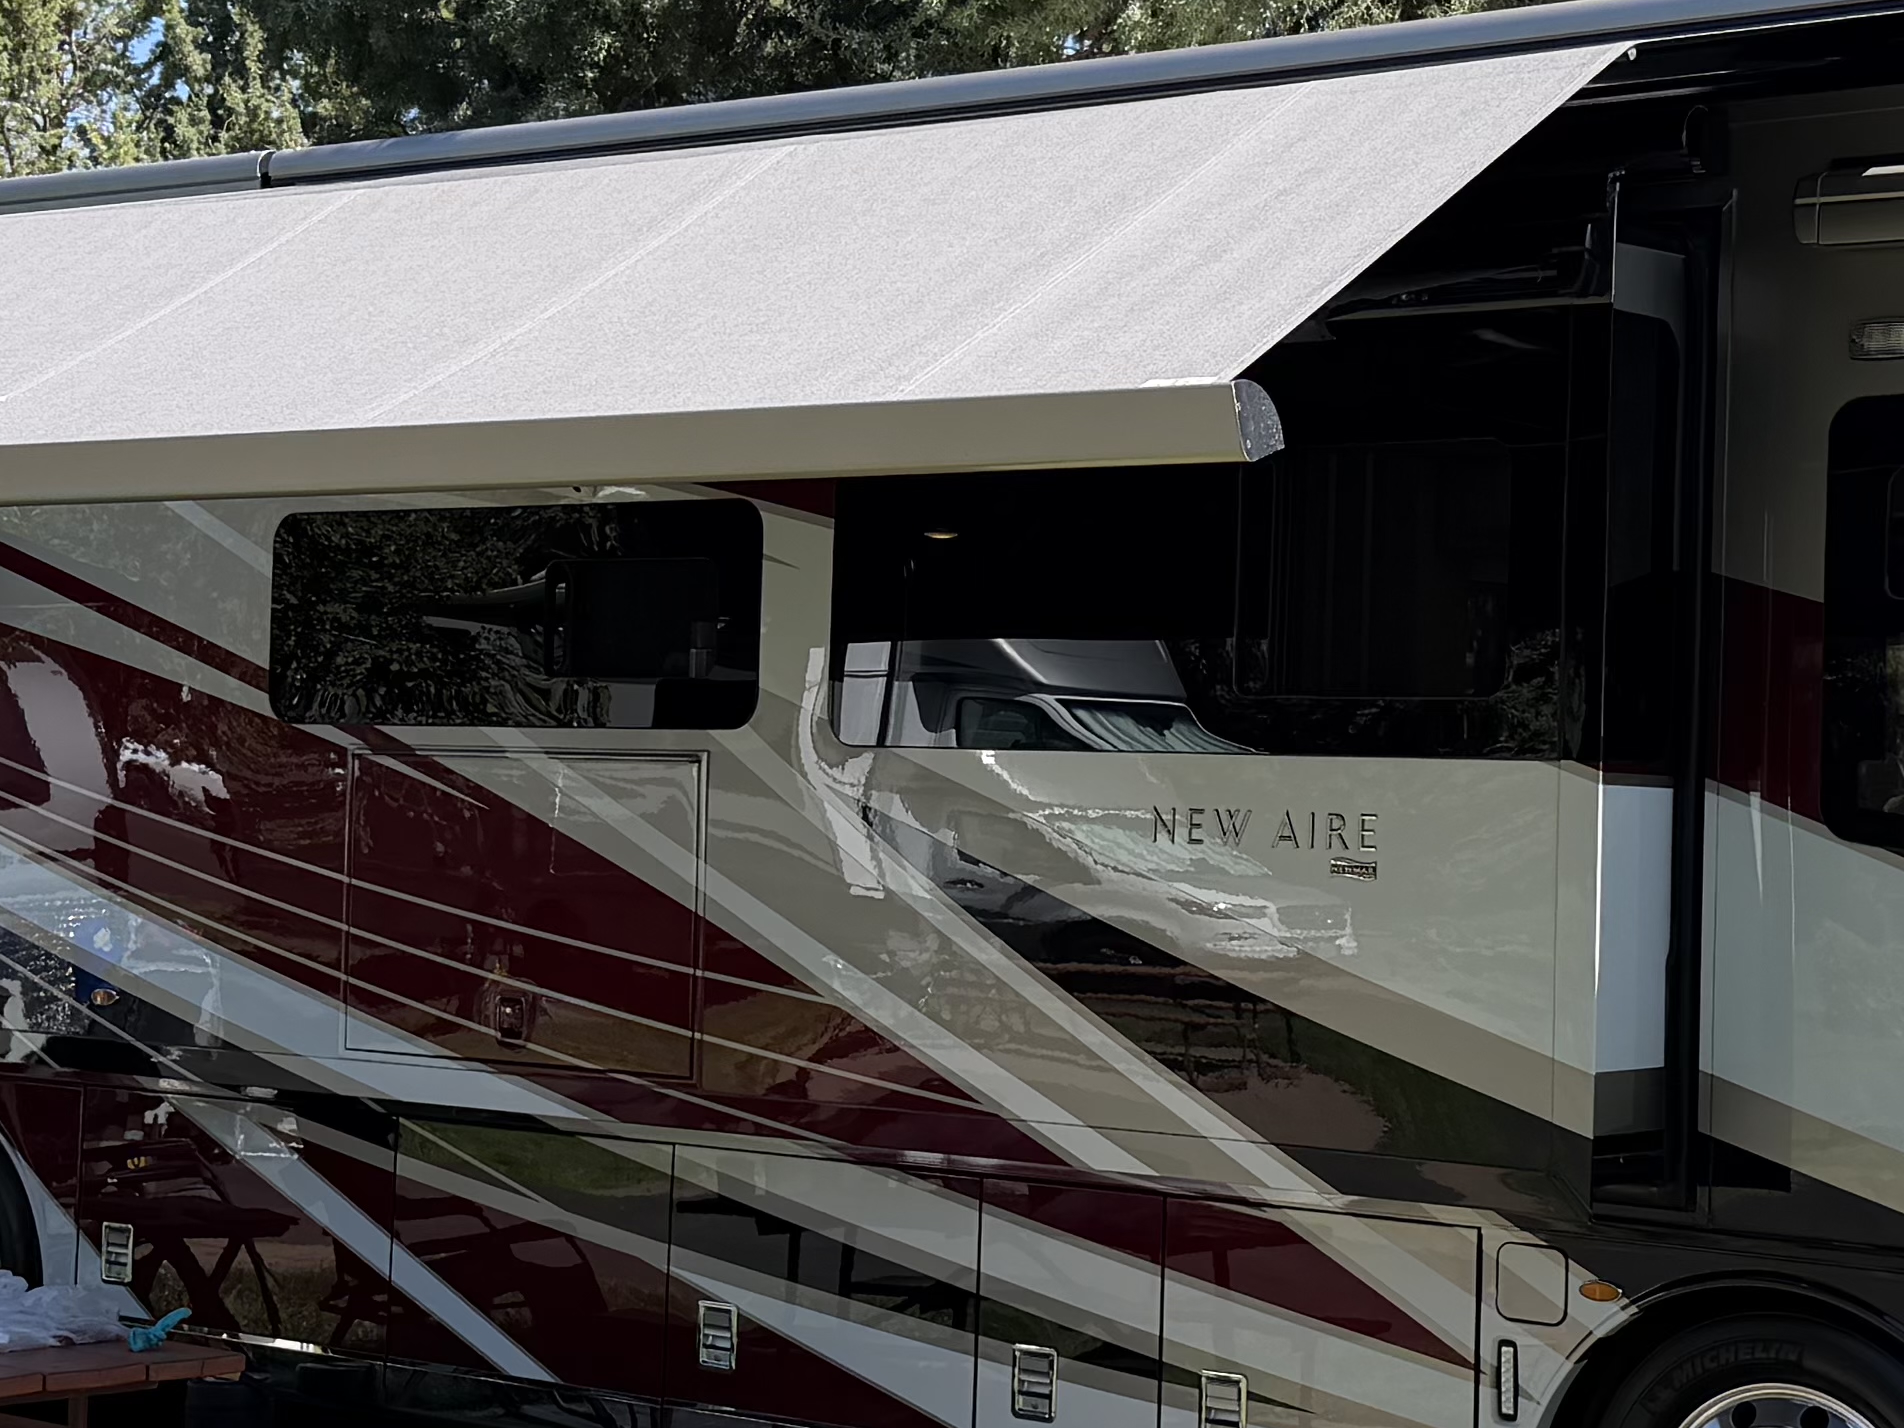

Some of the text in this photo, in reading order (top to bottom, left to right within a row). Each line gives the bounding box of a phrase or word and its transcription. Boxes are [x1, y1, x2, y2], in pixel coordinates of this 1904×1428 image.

[1151, 805, 1379, 852] NEW AIRE
[1672, 1340, 1802, 1386] MICHELIN
